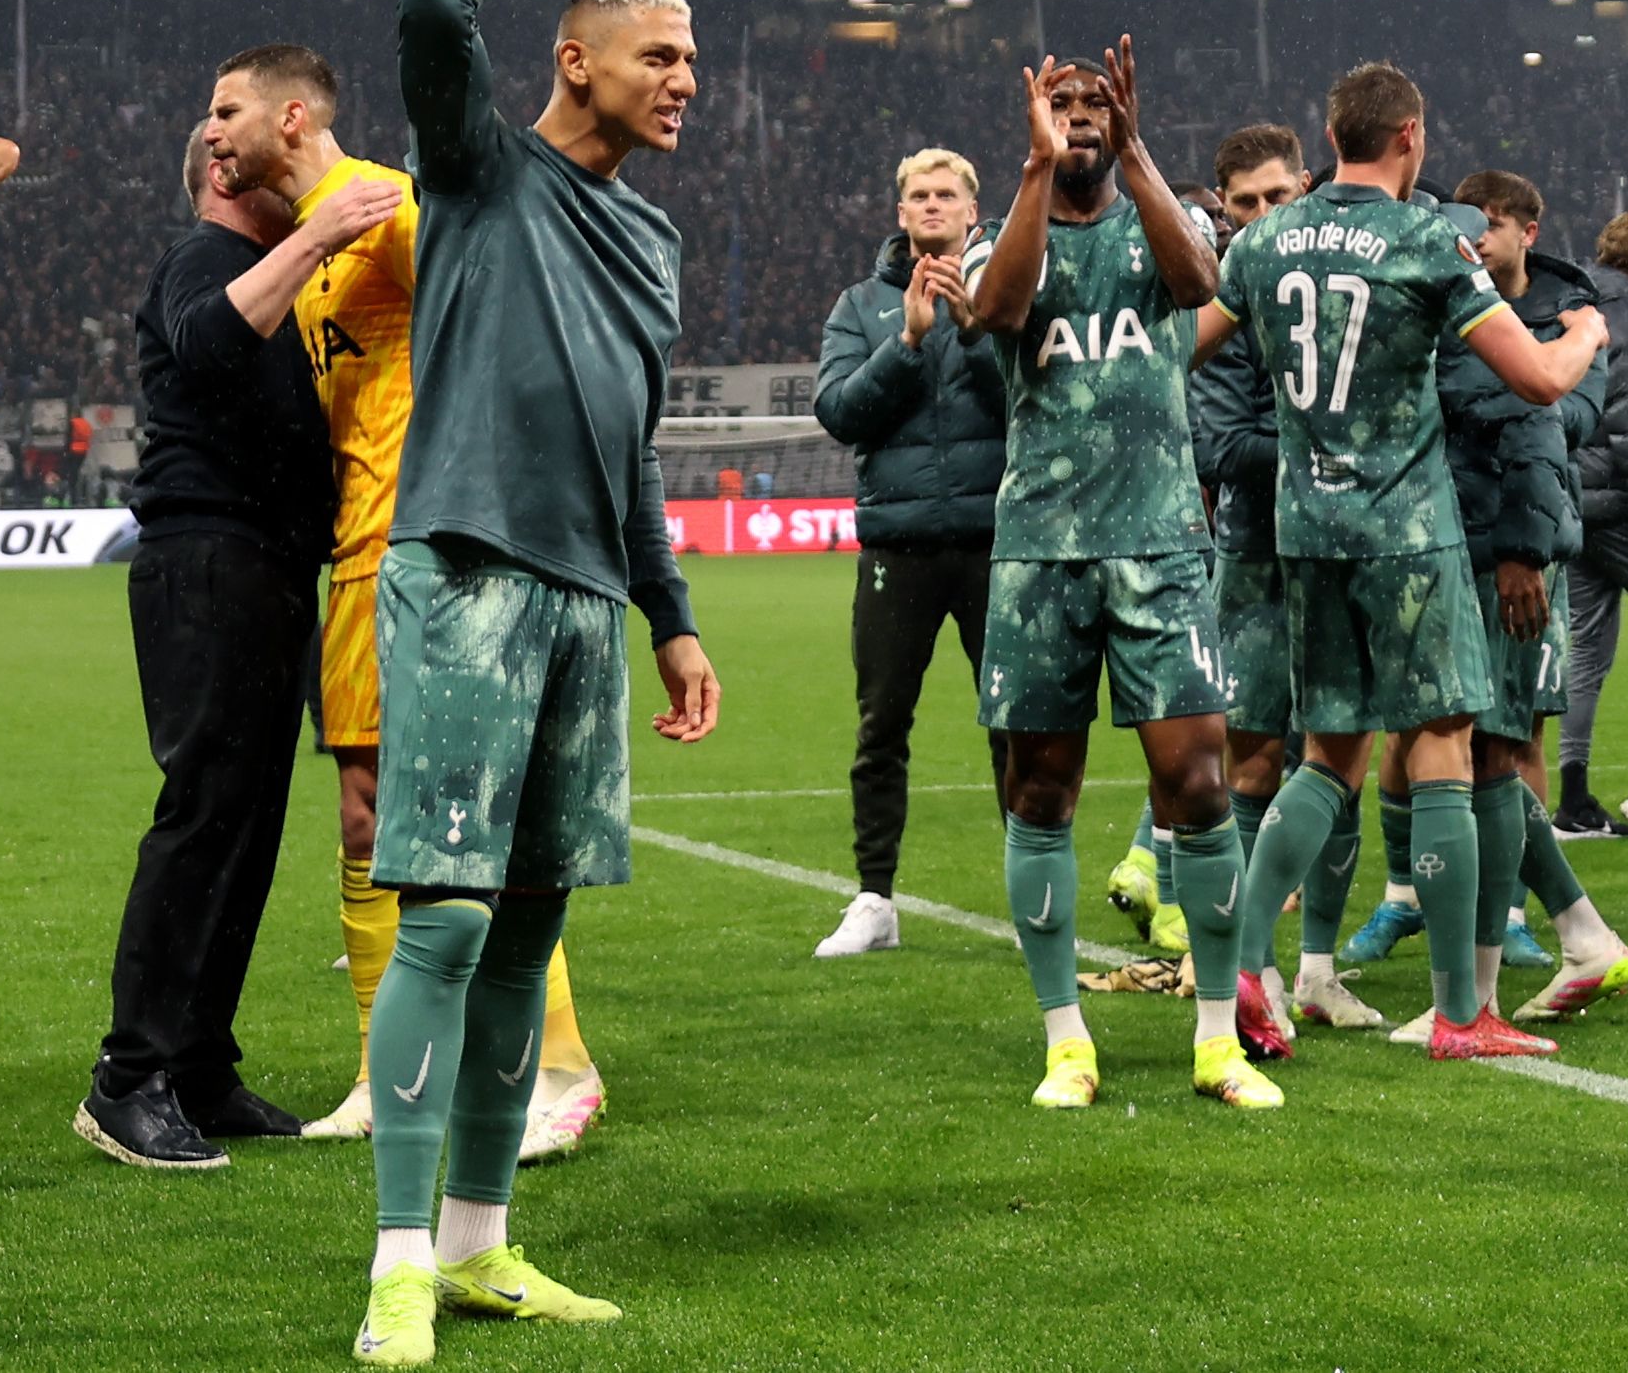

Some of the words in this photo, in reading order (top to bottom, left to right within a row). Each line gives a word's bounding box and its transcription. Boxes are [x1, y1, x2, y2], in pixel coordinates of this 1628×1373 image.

[1037, 307, 1154, 368] AIA
[1277, 270, 1371, 412] 37
[1189, 625, 1213, 683] 4
